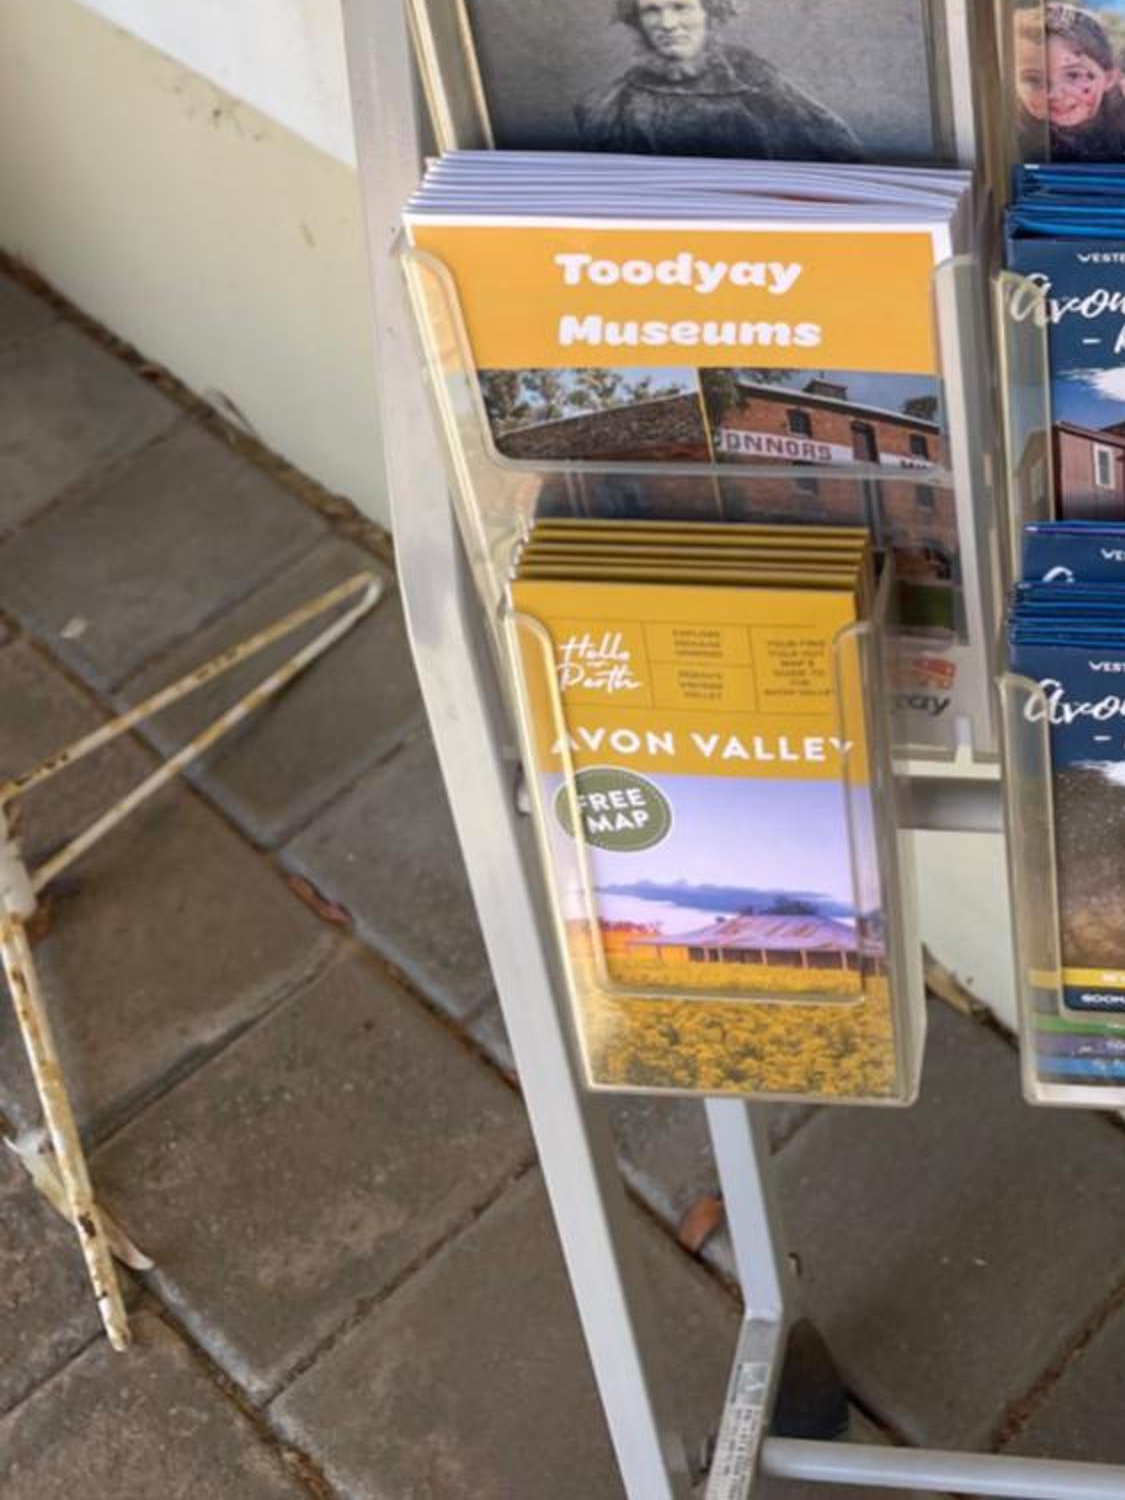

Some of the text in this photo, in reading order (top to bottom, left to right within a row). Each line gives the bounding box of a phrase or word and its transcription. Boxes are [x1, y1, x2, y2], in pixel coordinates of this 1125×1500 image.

[554, 252, 803, 294] Toodyay
[558, 315, 823, 348] Museums
[714, 431, 833, 462] ONNORS
[551, 727, 854, 762] AVON VALLEY
[586, 810, 649, 834] MAP
